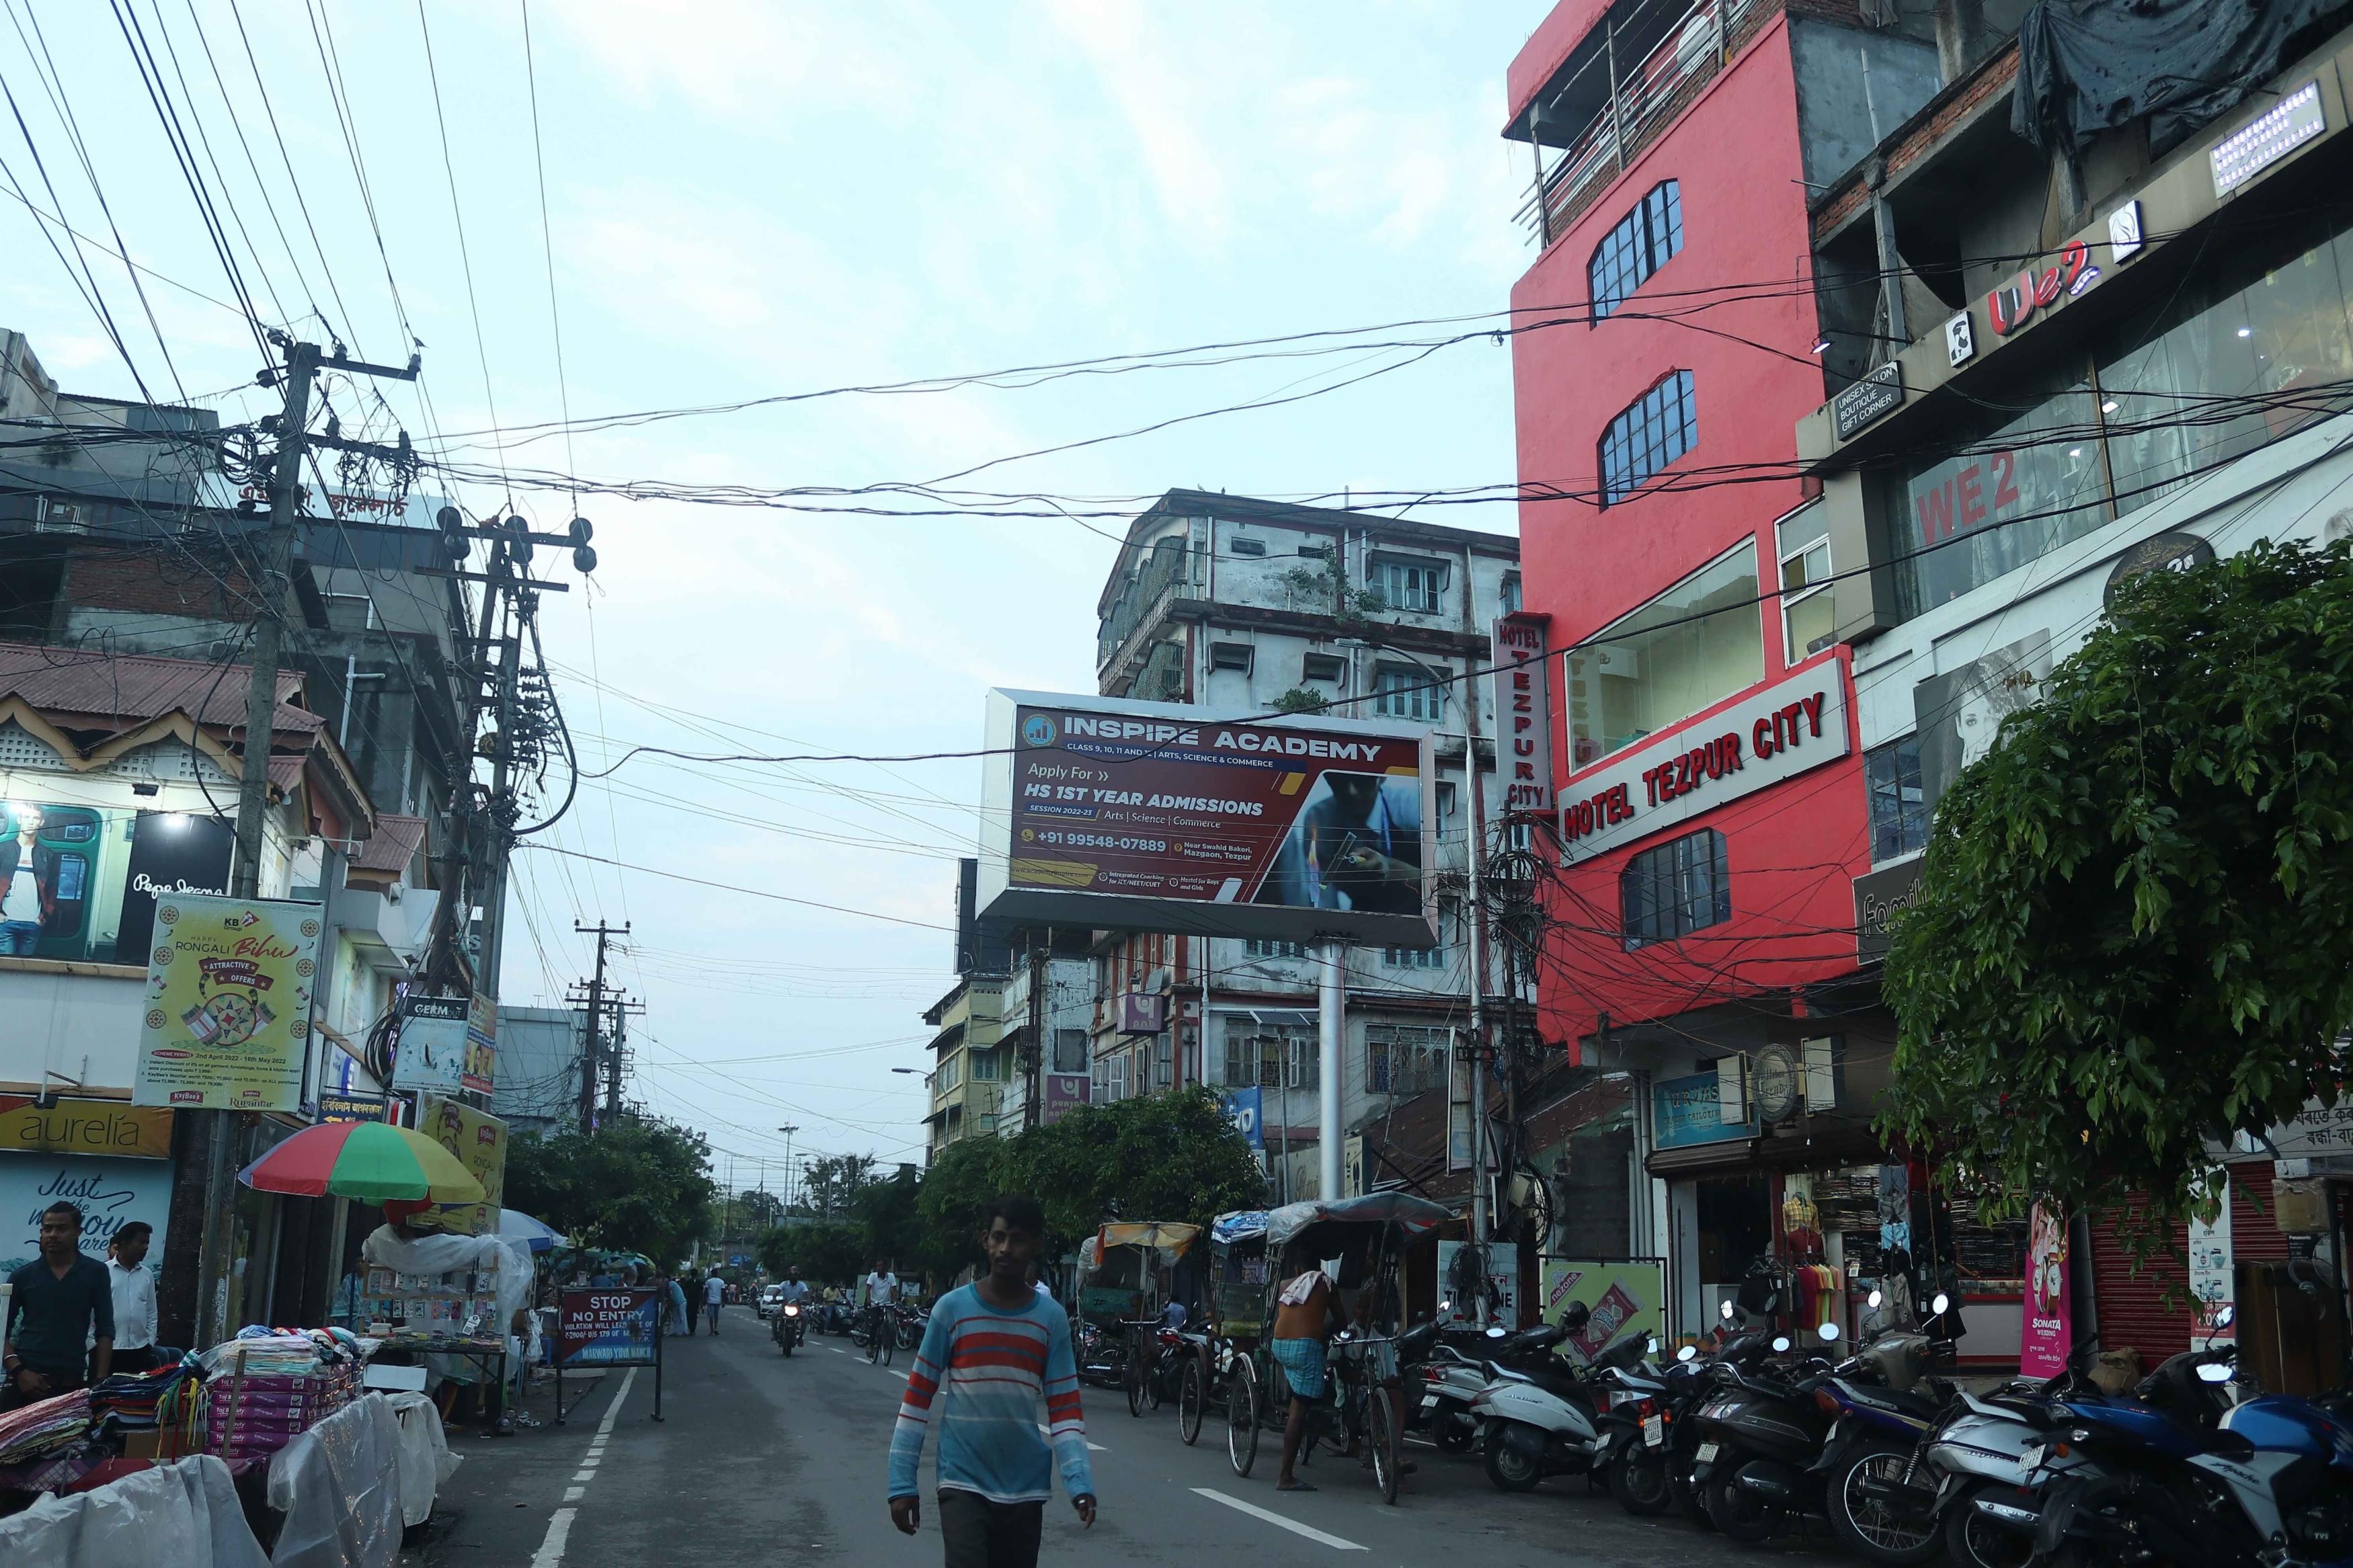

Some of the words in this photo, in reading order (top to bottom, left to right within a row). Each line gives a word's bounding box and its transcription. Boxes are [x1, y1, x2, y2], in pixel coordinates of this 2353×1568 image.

[1839, 384, 1866, 409] UNISEX
[1866, 368, 1892, 390] SALON
[1840, 389, 1878, 421] BOUTIQUE
[1842, 415, 1858, 431] GIFT
[1859, 393, 1892, 420] CORNER
[1916, 462, 1987, 546] WE
[1990, 451, 2019, 511] 2
[1499, 625, 1540, 648] HOTEL
[1511, 650, 1535, 780] TEZPUR
[1064, 716, 1199, 746] INSPIRE
[1213, 731, 1382, 762] ACADEMY
[1067, 743, 1094, 752] CLASS
[1095, 745, 1103, 753] 9,
[1104, 746, 1115, 755] 10,
[1123, 747, 1143, 756] AND
[1158, 751, 1182, 761] ARTS,
[1183, 753, 1218, 764] SCIENCE
[1219, 755, 1225, 764] &
[1227, 757, 1274, 768] COMMERCE
[1028, 763, 1068, 780] Apply
[1071, 766, 1092, 780] For
[1564, 782, 1634, 843] HOTEL
[1642, 732, 1743, 807] TEZPUR
[1753, 692, 1825, 759] CITY
[1024, 782, 1051, 798] HS
[1055, 786, 1088, 802] 1ST
[1092, 789, 1144, 807] YEAR
[1146, 794, 1264, 817] ADMISSIONS
[1508, 784, 1544, 806] CITY
[1029, 804, 1062, 814] SESSION
[1063, 807, 1093, 816] 2022-23
[1103, 811, 1124, 821] Arts
[1131, 813, 1166, 825] Science
[1173, 816, 1222, 829] Commerce
[1038, 831, 1063, 844] +91
[1067, 833, 1166, 852] 99548-07889
[1201, 843, 1227, 852] Swahid
[1228, 845, 1252, 854] Bakori,
[1184, 850, 1222, 860] Mazgaon,
[1224, 852, 1252, 862] Tezpur
[1140, 873, 1165, 882] Coaching
[133, 874, 173, 899] Pepe
[224, 918, 239, 927] KB
[175, 941, 230, 955] RONGALI
[232, 934, 298, 958] Bihu
[209, 962, 249, 970] ATTRACTIVE
[231, 975, 256, 985] OFFERS
[1133, 1019, 1155, 1028] pnb
[174, 1091, 200, 1101] KayBee's
[38, 1169, 116, 1200] Just
[70, 1199, 91, 1214] the
[1551, 1272, 1579, 1303] nezone
[590, 1296, 631, 1309] STOP
[573, 1311, 594, 1322] NO
[599, 1310, 645, 1321] ENTRY
[2032, 1317, 2061, 1331] SONATA
[564, 1322, 593, 1331] VIOLATION
[612, 1329, 619, 1337] OF
[2036, 1329, 2057, 1337] WEDDING
[582, 1347, 613, 1360] MARWARI
[614, 1347, 630, 1359] YUVA
[2209, 1462, 2260, 1485] Apache
[2314, 1532, 2329, 1540] TVS
